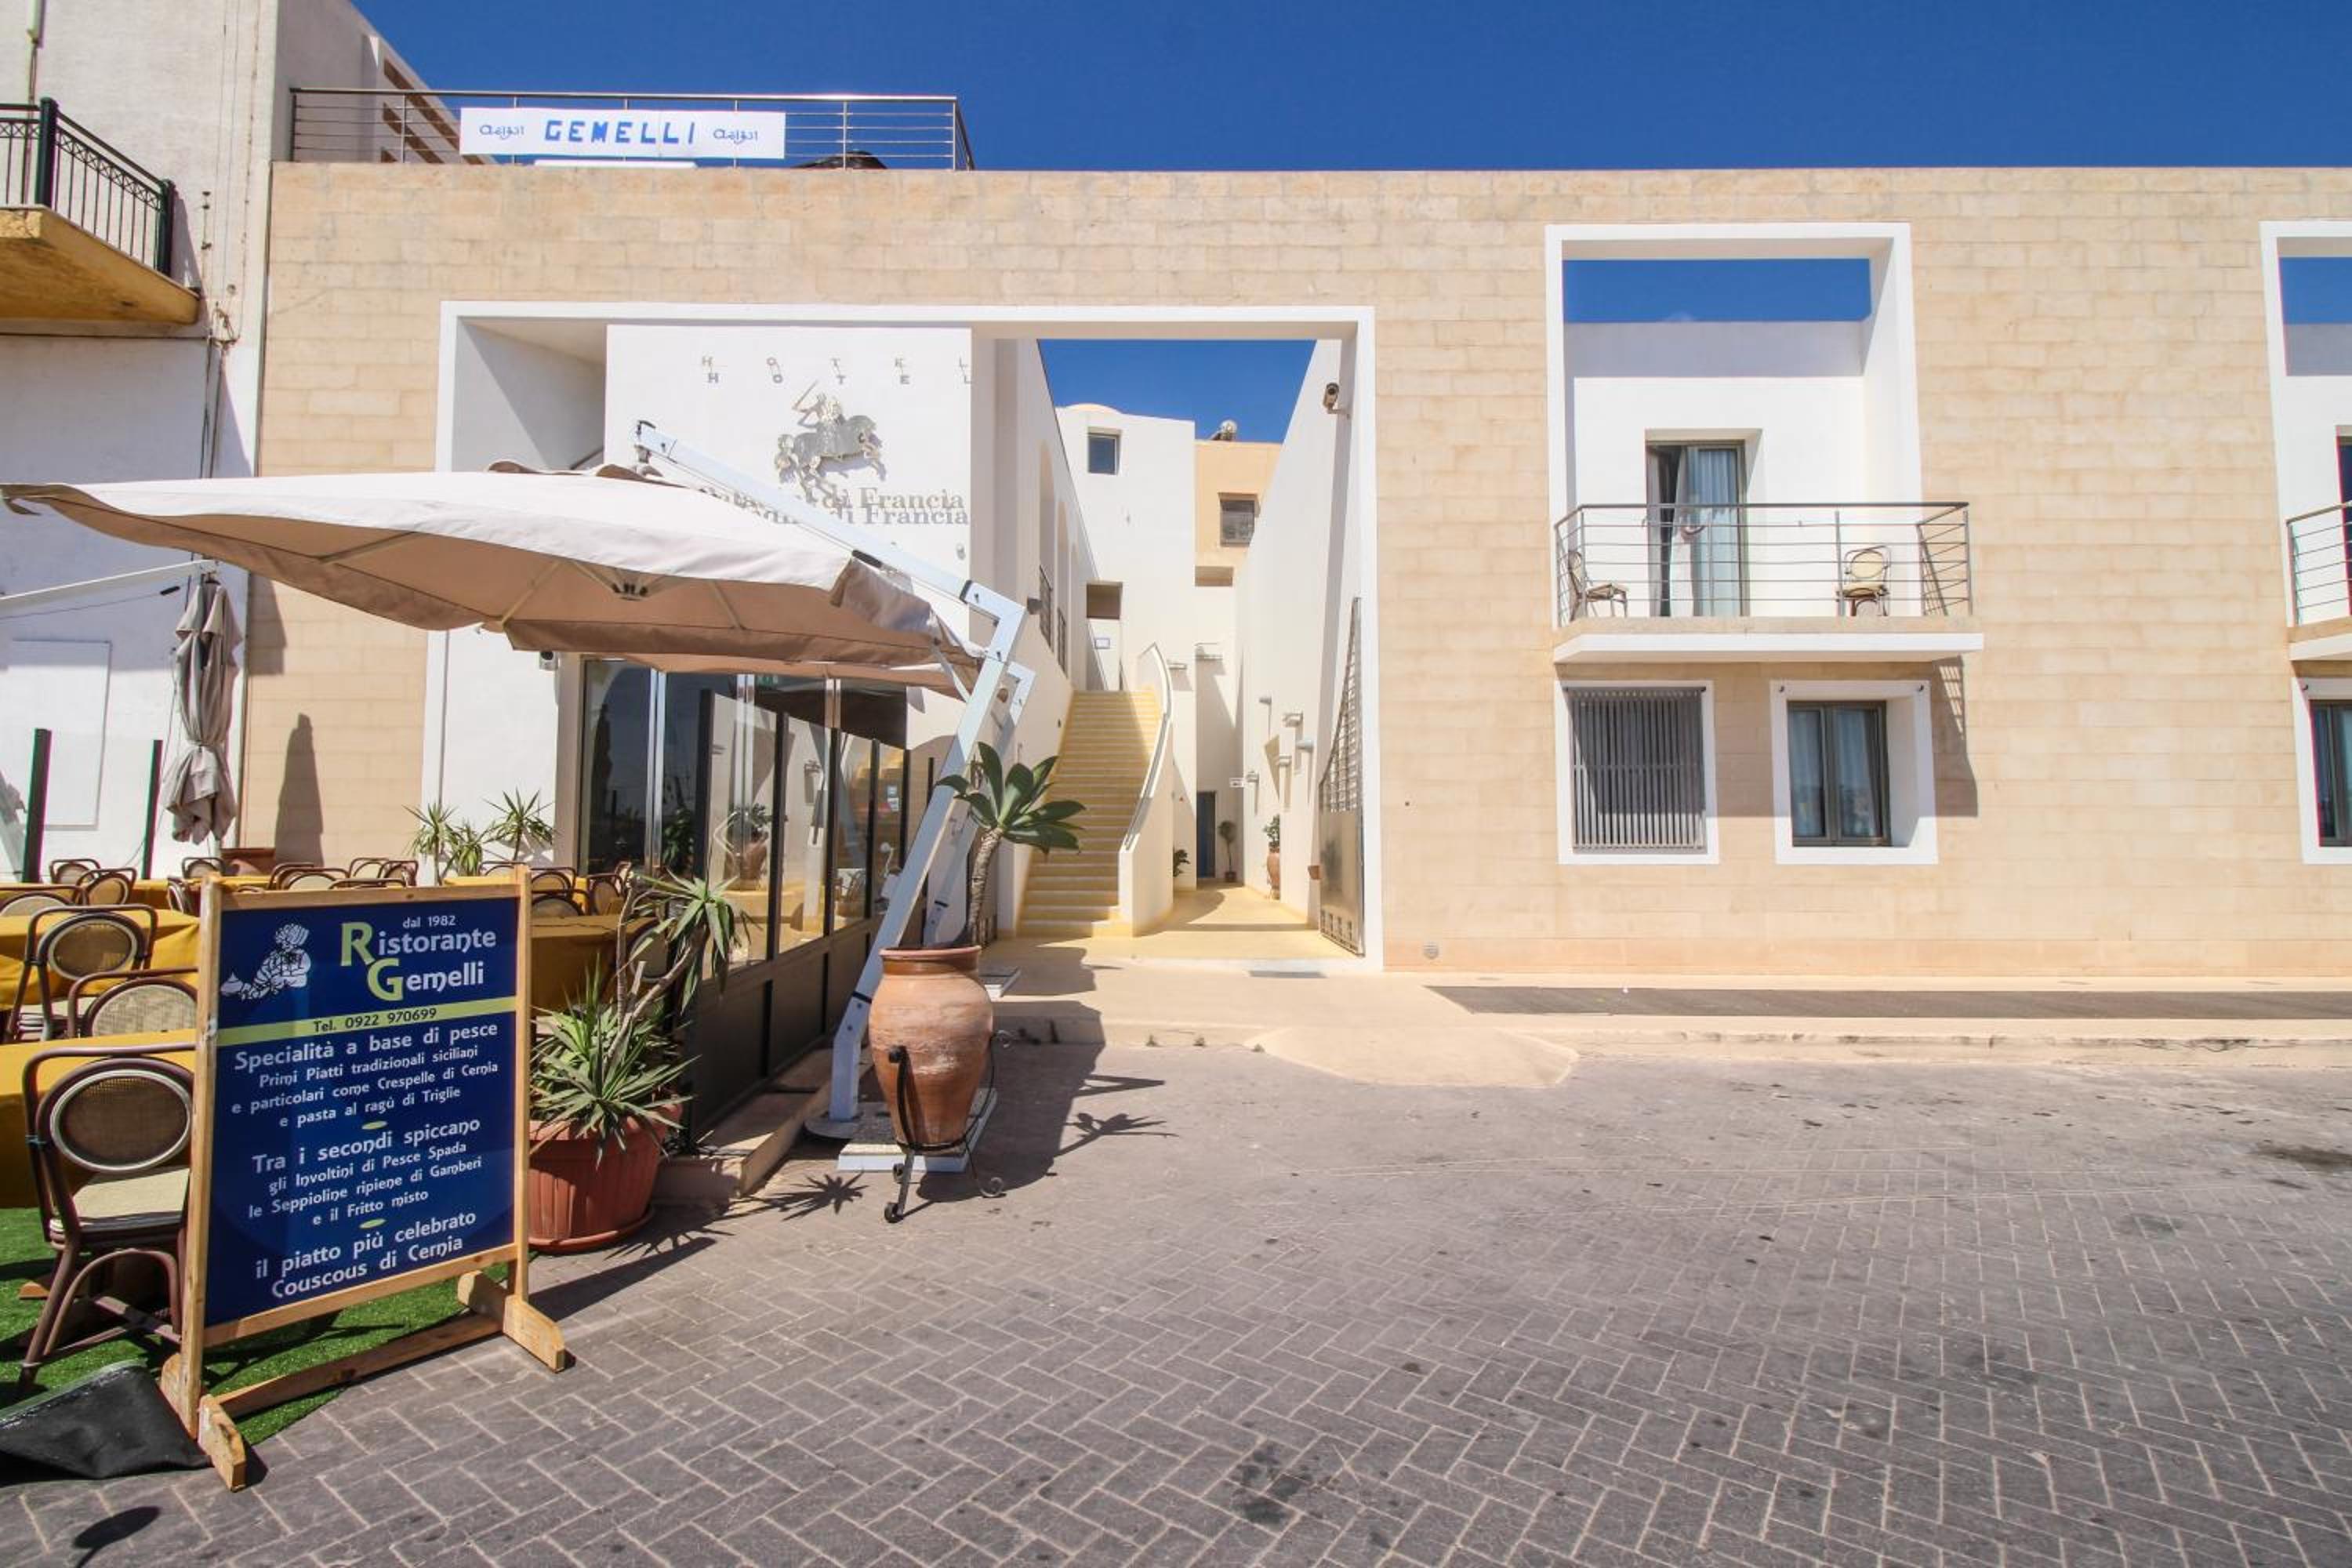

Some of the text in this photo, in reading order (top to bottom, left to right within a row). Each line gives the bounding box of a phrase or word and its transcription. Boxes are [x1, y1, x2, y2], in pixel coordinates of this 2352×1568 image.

[544, 120, 695, 144] GEMELLI
[402, 915, 456, 928] dal 1982
[340, 922, 496, 967] Ristorante
[368, 957, 484, 1001] Gemelli
[314, 1007, 437, 1033] Tel. 0922 970699
[234, 1024, 498, 1073] Specialità a base di pesce
[260, 1045, 477, 1087] Primi Piatti tradizionali siciliani
[231, 1062, 498, 1114] e particolari come Crespelle di Cernia
[279, 1086, 461, 1127] e pasta al ragù di Triglie
[252, 1119, 481, 1174] Tra i secondi spiccano
[269, 1142, 466, 1196] gli Involtini di Pesce Spada
[249, 1156, 481, 1218] le Seppioline ripiene di Gamberi
[313, 1191, 429, 1225] e il Fritto misto
[256, 1213, 477, 1279] il piatto più celebrato
[272, 1236, 463, 1298] Couscous di Cernia
